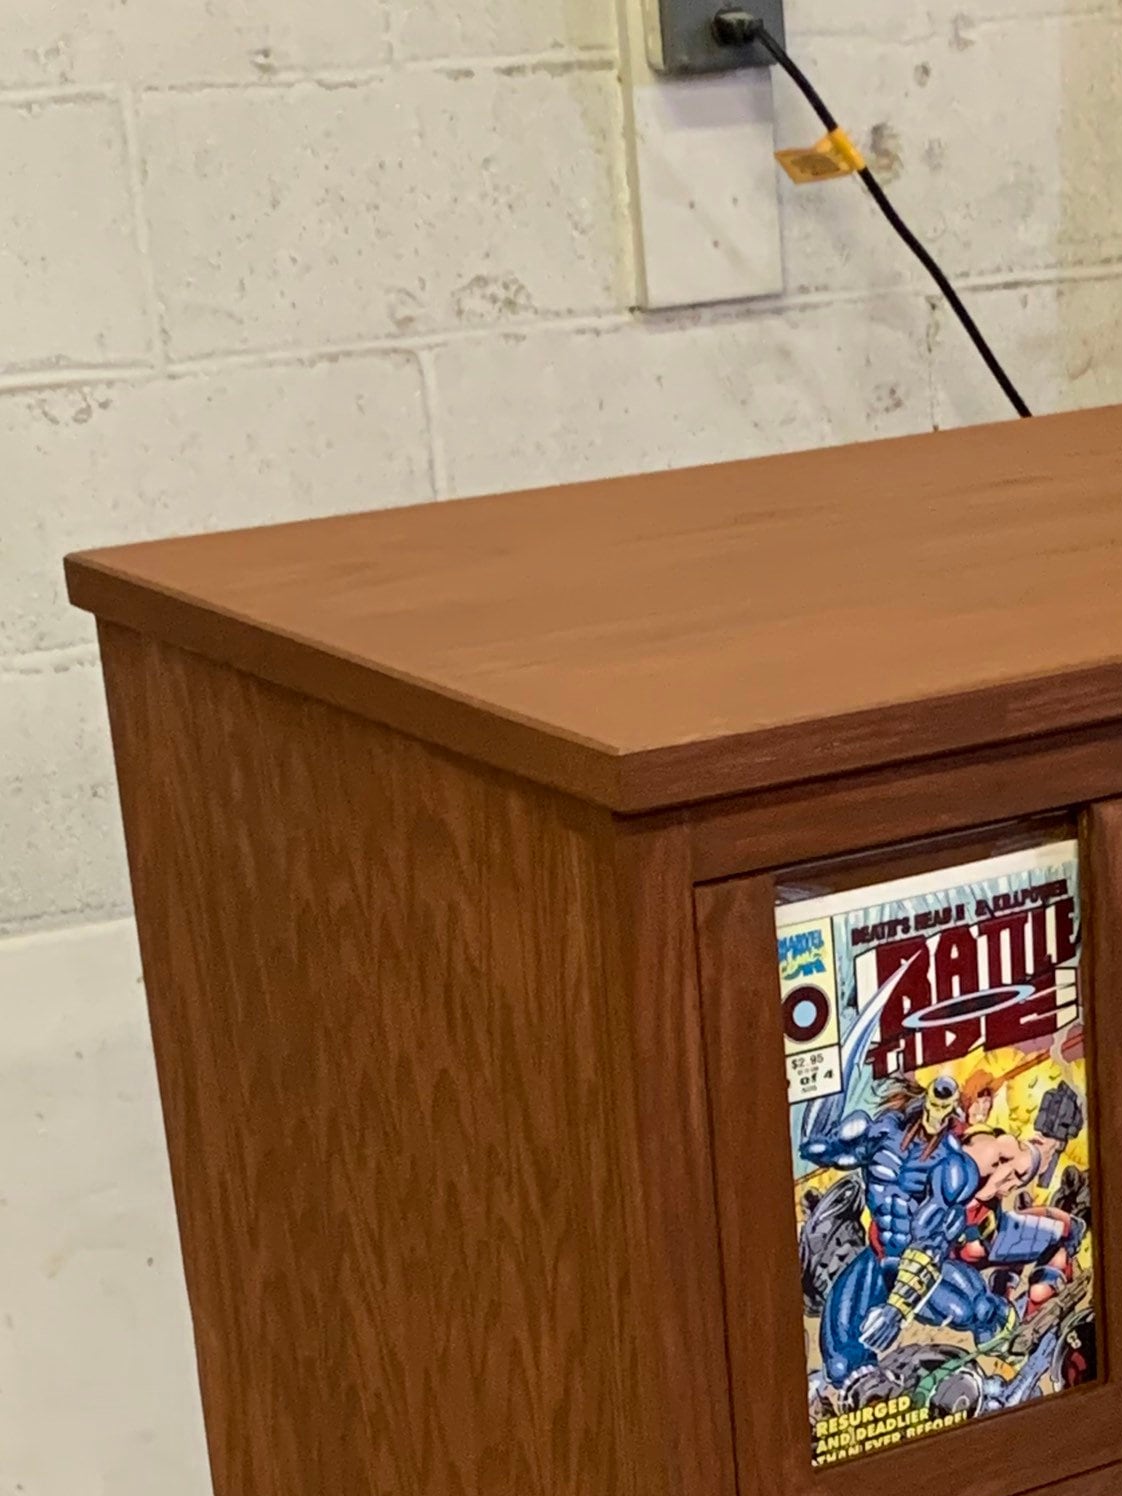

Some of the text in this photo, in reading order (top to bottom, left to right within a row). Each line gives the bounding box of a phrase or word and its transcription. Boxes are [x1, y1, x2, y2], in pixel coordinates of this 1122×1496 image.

[822, 1068, 835, 1080] 4
[814, 1395, 913, 1438] RESURGED
[816, 1407, 930, 1454] AND DEADLIER
